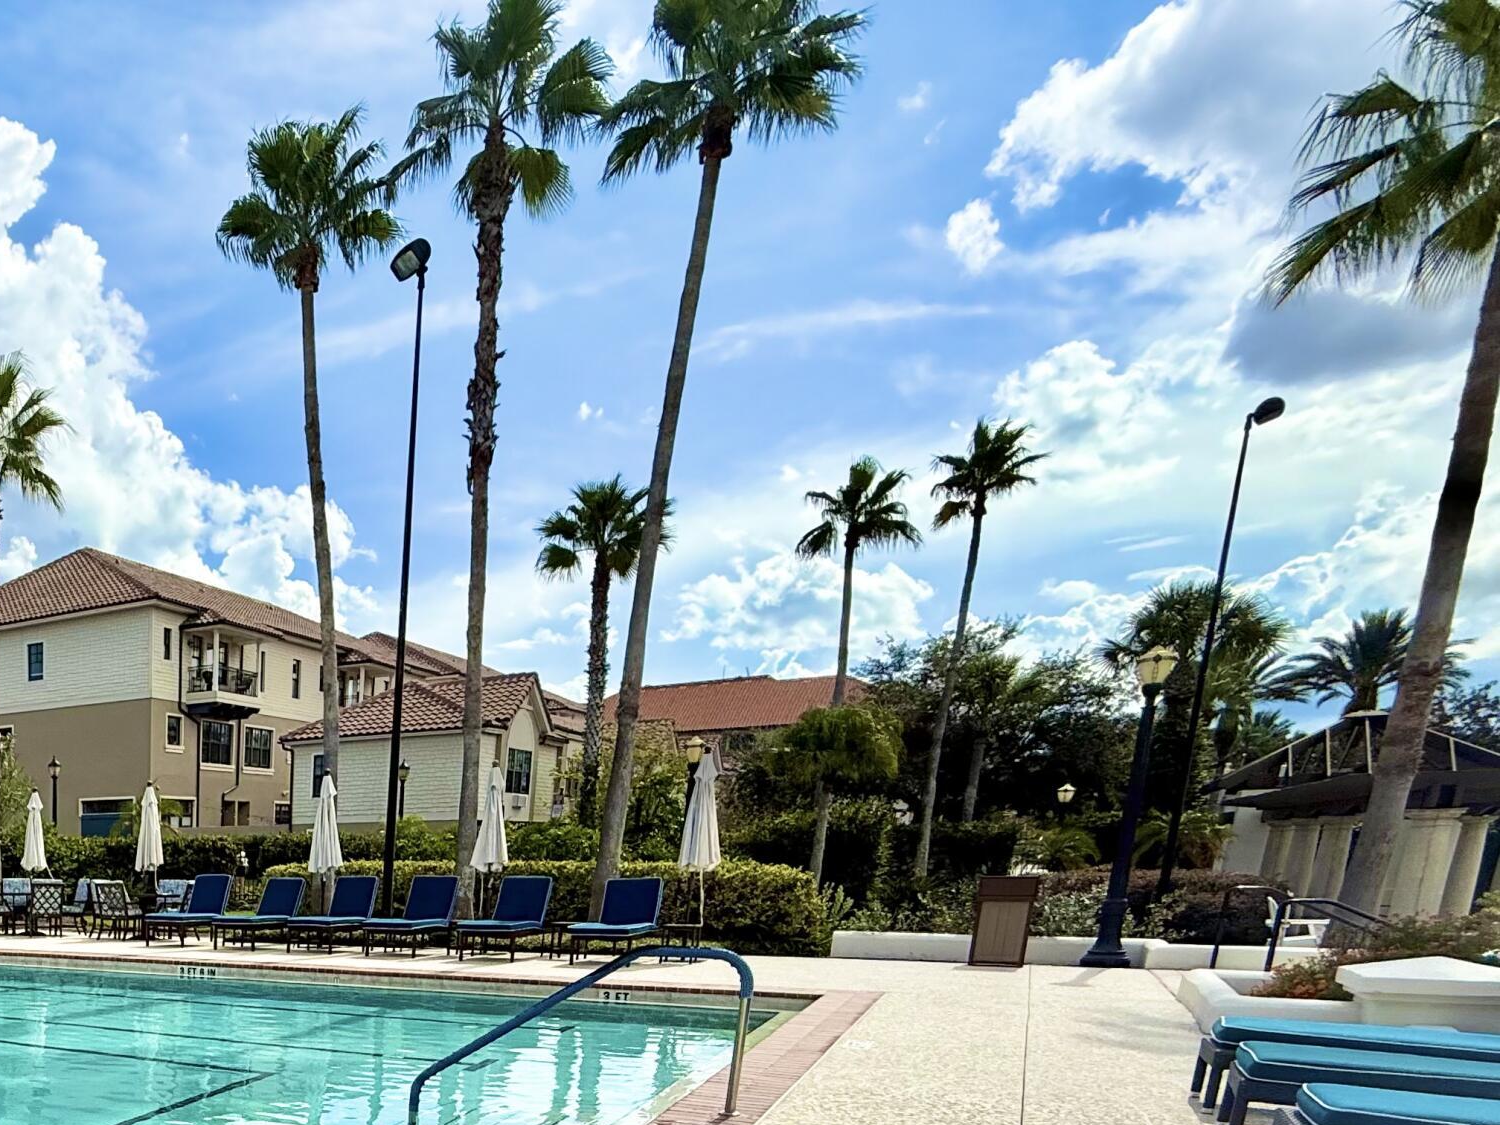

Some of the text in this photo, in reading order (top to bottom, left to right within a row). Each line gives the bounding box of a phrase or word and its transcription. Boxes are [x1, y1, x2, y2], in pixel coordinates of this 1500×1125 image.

[188, 967, 197, 976] FT
[603, 991, 630, 1001] 3 FT
